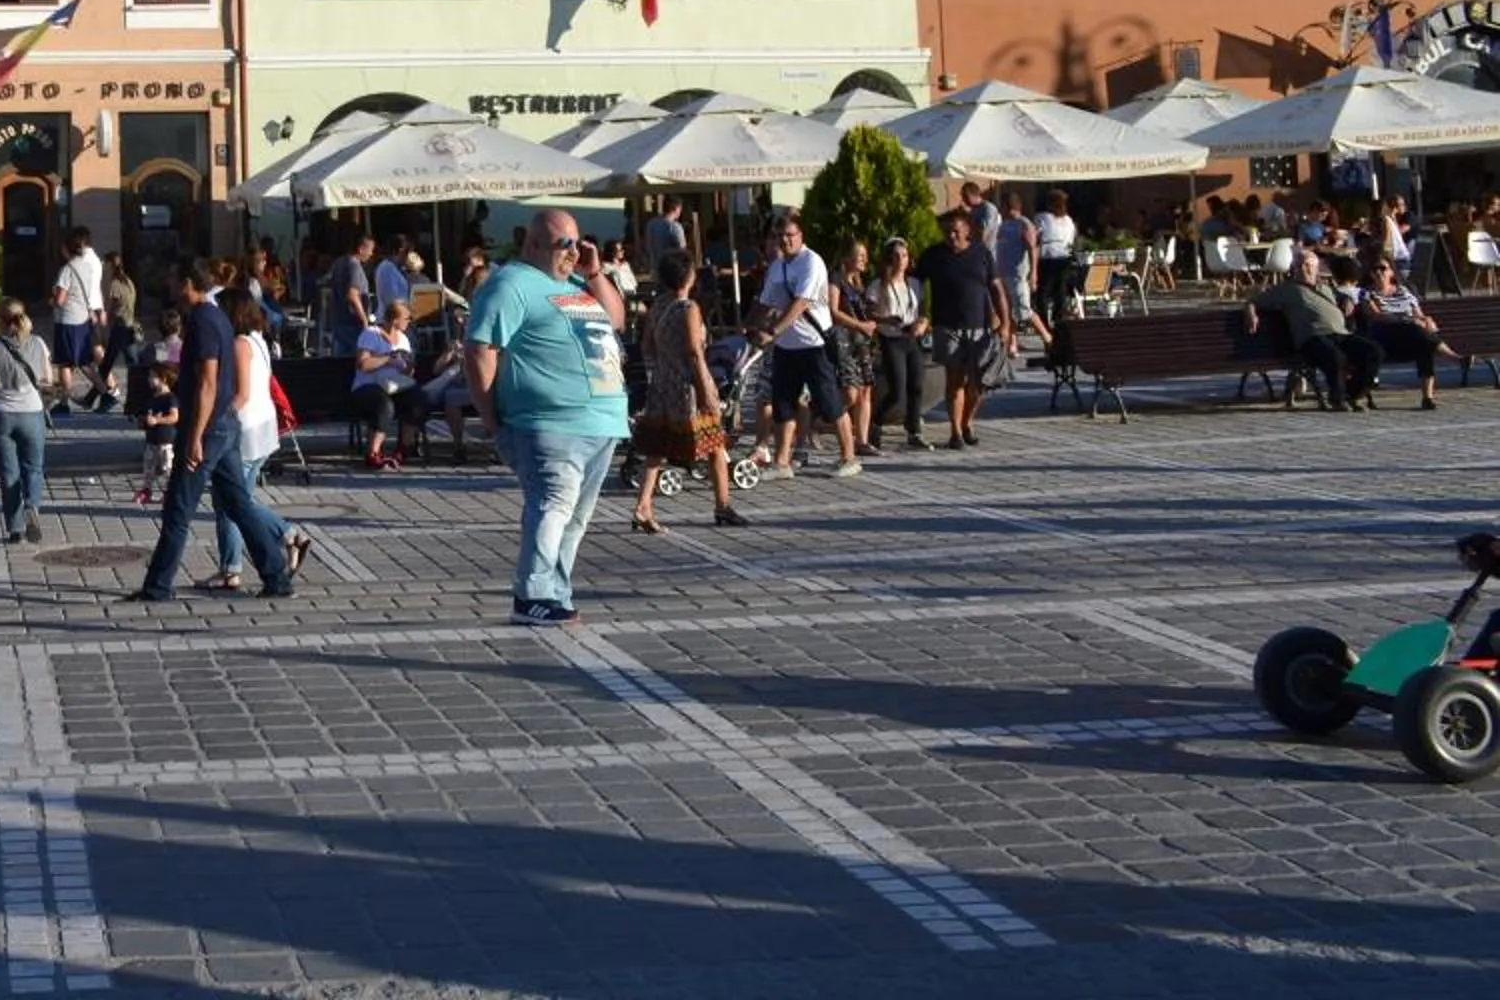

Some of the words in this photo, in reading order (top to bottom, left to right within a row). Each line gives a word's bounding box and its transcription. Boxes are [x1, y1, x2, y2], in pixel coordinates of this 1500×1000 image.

[1415, 38, 1451, 75] BUL
[100, 82, 205, 100] PRONO
[468, 93, 622, 115] RESTAURANT
